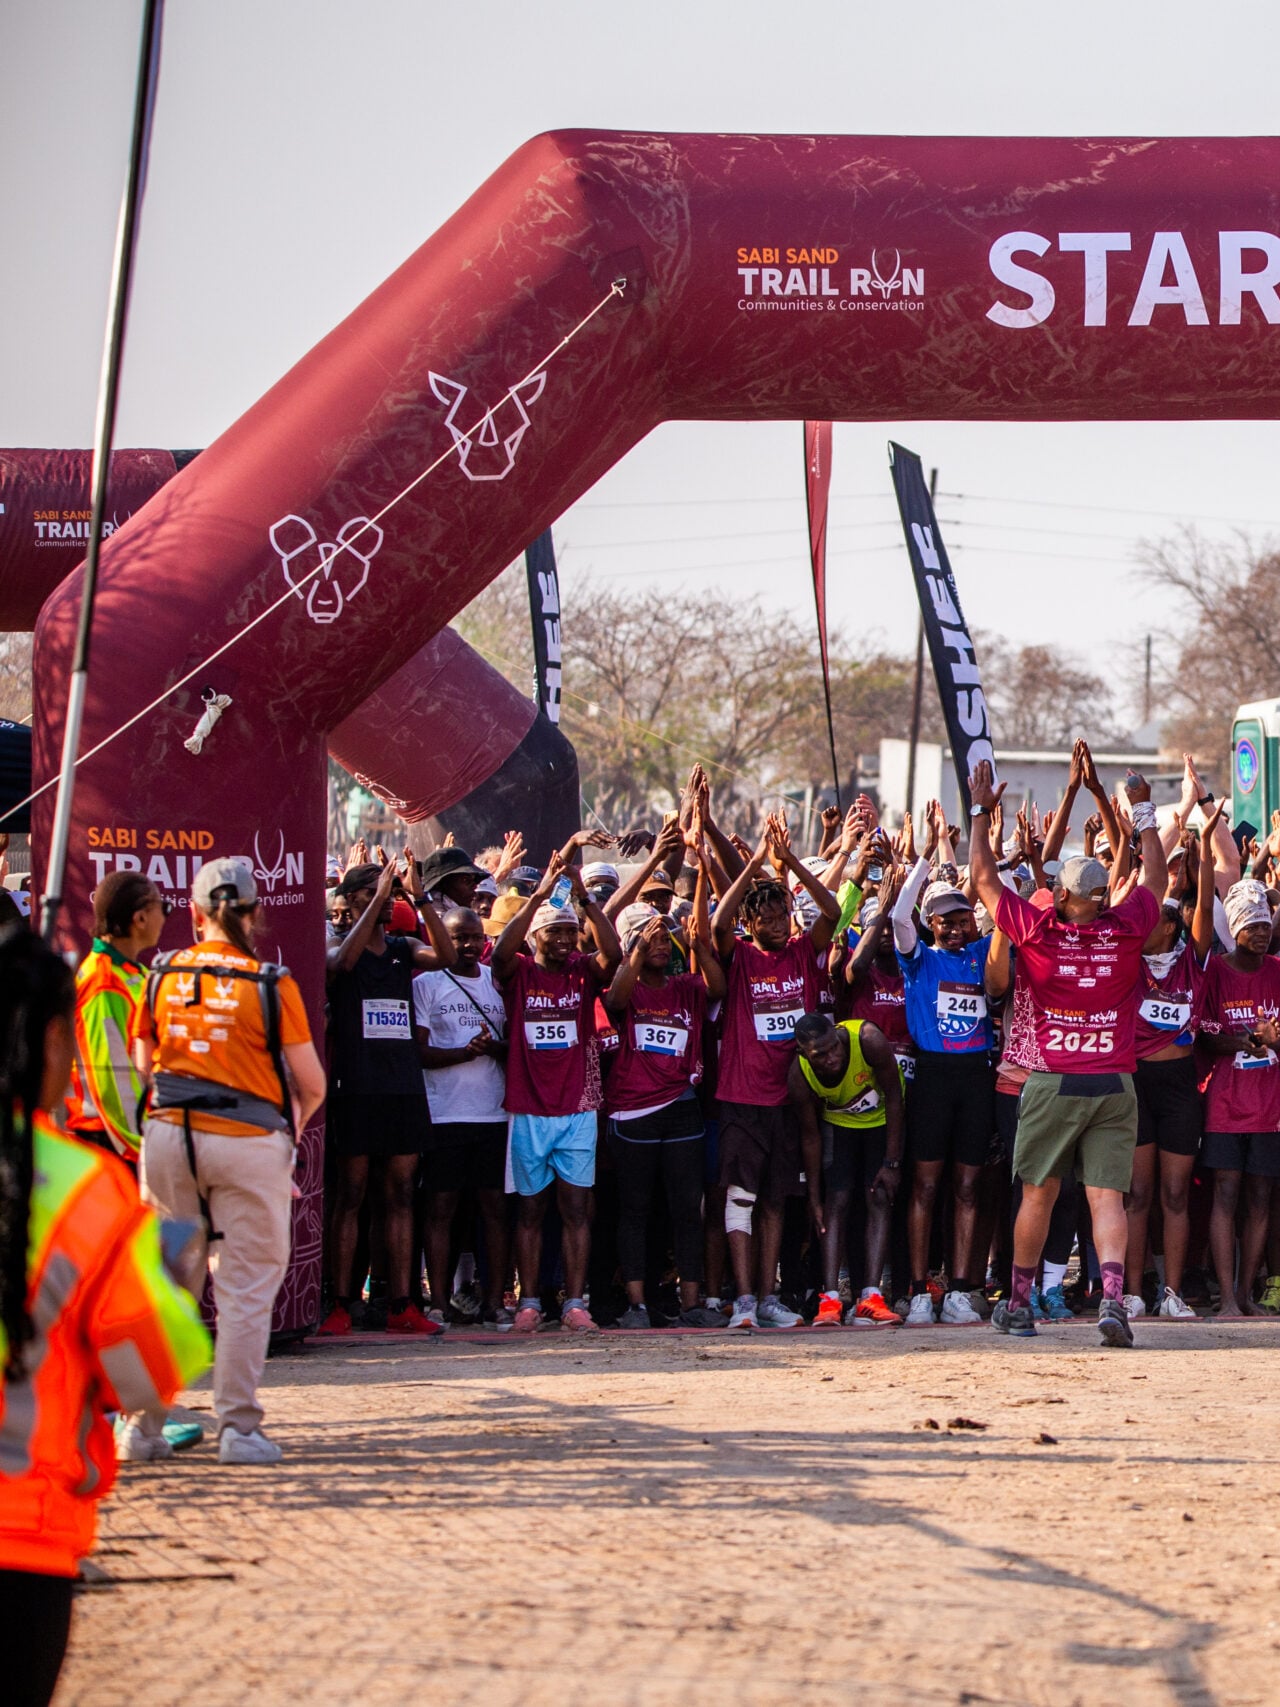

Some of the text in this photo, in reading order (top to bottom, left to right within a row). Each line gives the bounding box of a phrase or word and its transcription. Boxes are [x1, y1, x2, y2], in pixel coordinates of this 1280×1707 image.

[737, 247, 839, 264] SABI SAND
[738, 268, 839, 296] TRAIL
[737, 299, 925, 312] Communities & Conservation
[33, 510, 59, 520] SABI
[34, 540, 86, 548] Communities
[88, 826, 214, 850] SABI SAND
[440, 1003, 468, 1015] SABI
[948, 997, 977, 1013] 244
[1064, 1009, 1086, 1017] SAND
[1149, 1004, 1180, 1021] 364
[367, 1011, 408, 1026] T15323
[766, 1015, 796, 1031] 390
[535, 1025, 566, 1040] 356
[645, 1028, 677, 1045] 367
[1046, 1029, 1114, 1053] 2025
